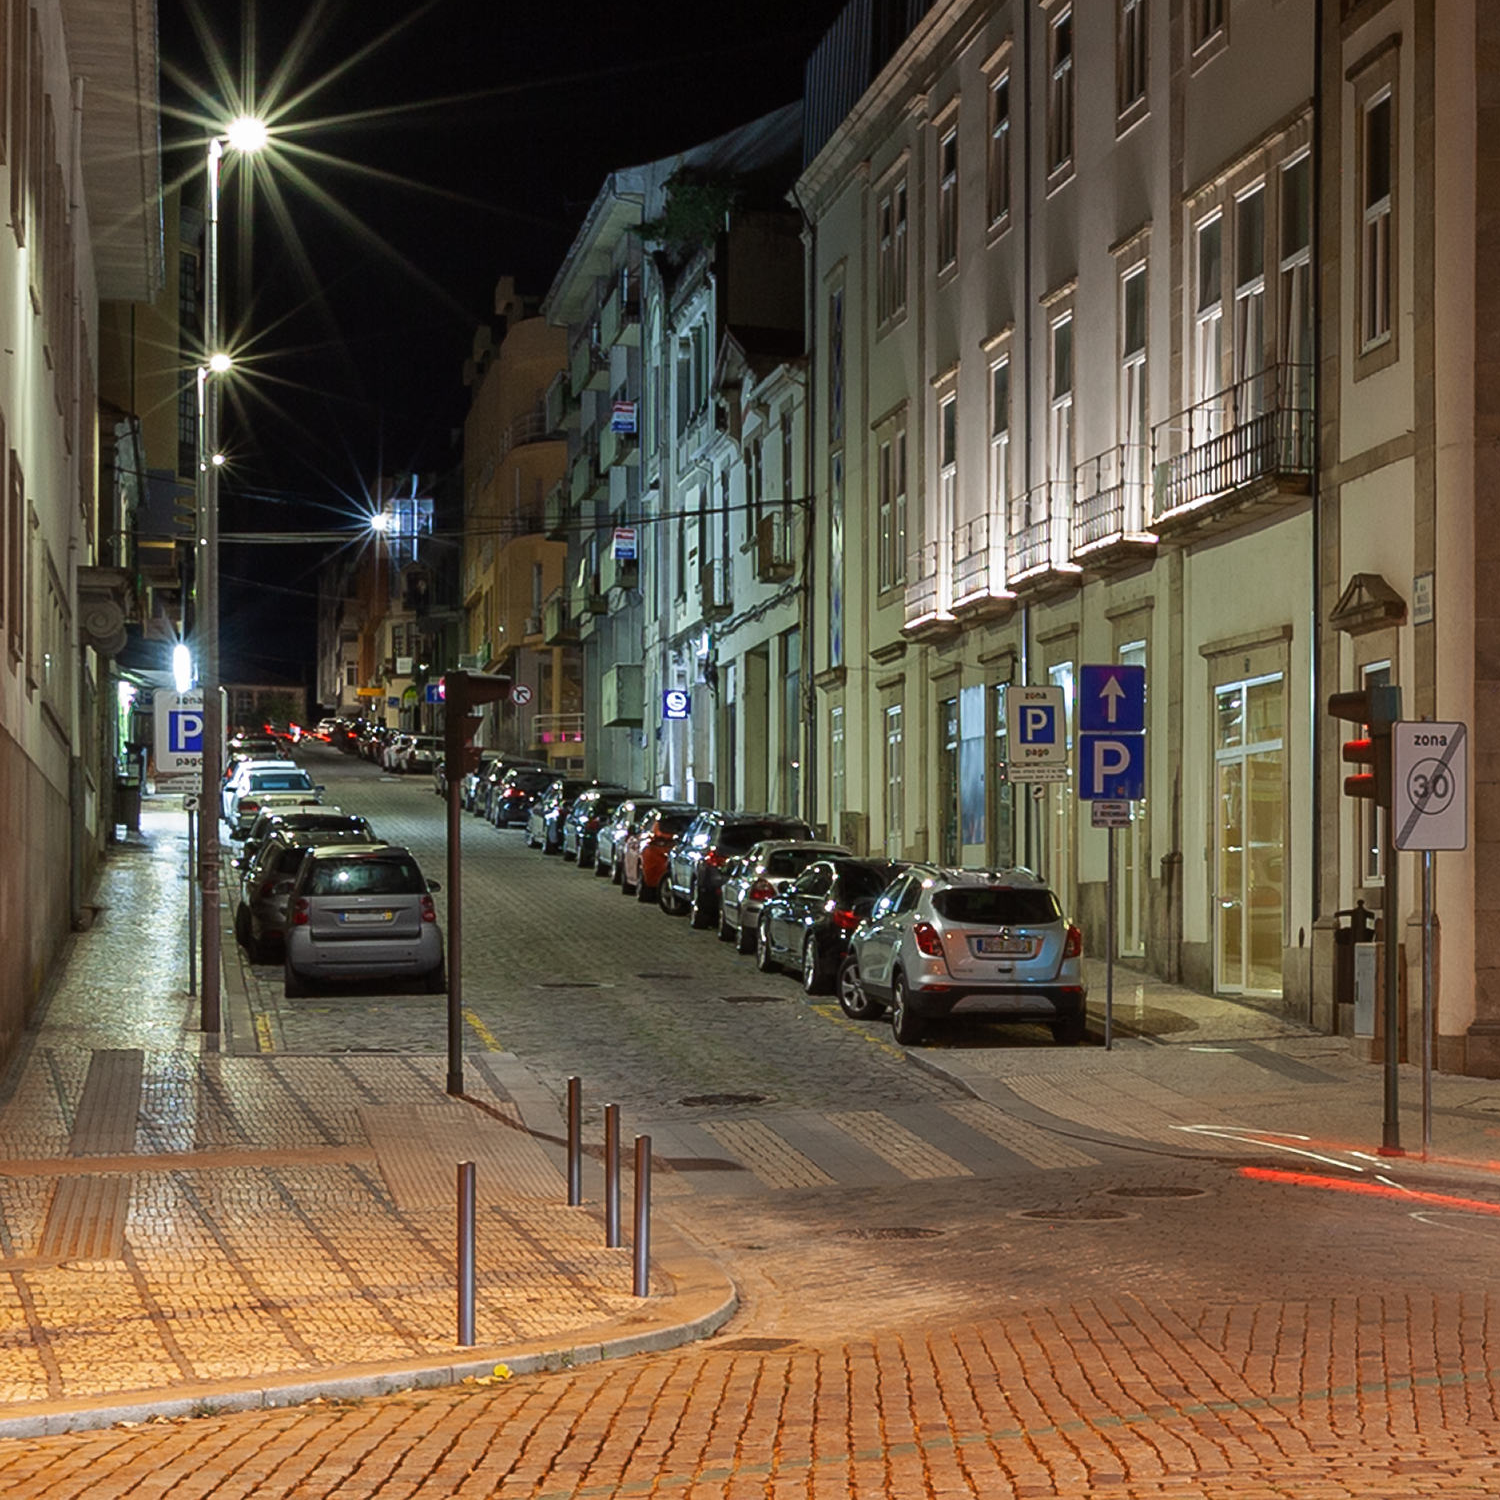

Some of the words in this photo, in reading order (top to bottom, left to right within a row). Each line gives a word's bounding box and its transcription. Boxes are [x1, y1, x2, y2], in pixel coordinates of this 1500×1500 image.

[1025, 692, 1047, 700] zona
[177, 714, 203, 750] P
[1026, 708, 1048, 741] P
[1025, 748, 1050, 758] pago
[1413, 734, 1448, 747] zona
[1094, 741, 1131, 794] P
[1413, 773, 1449, 799] 30
